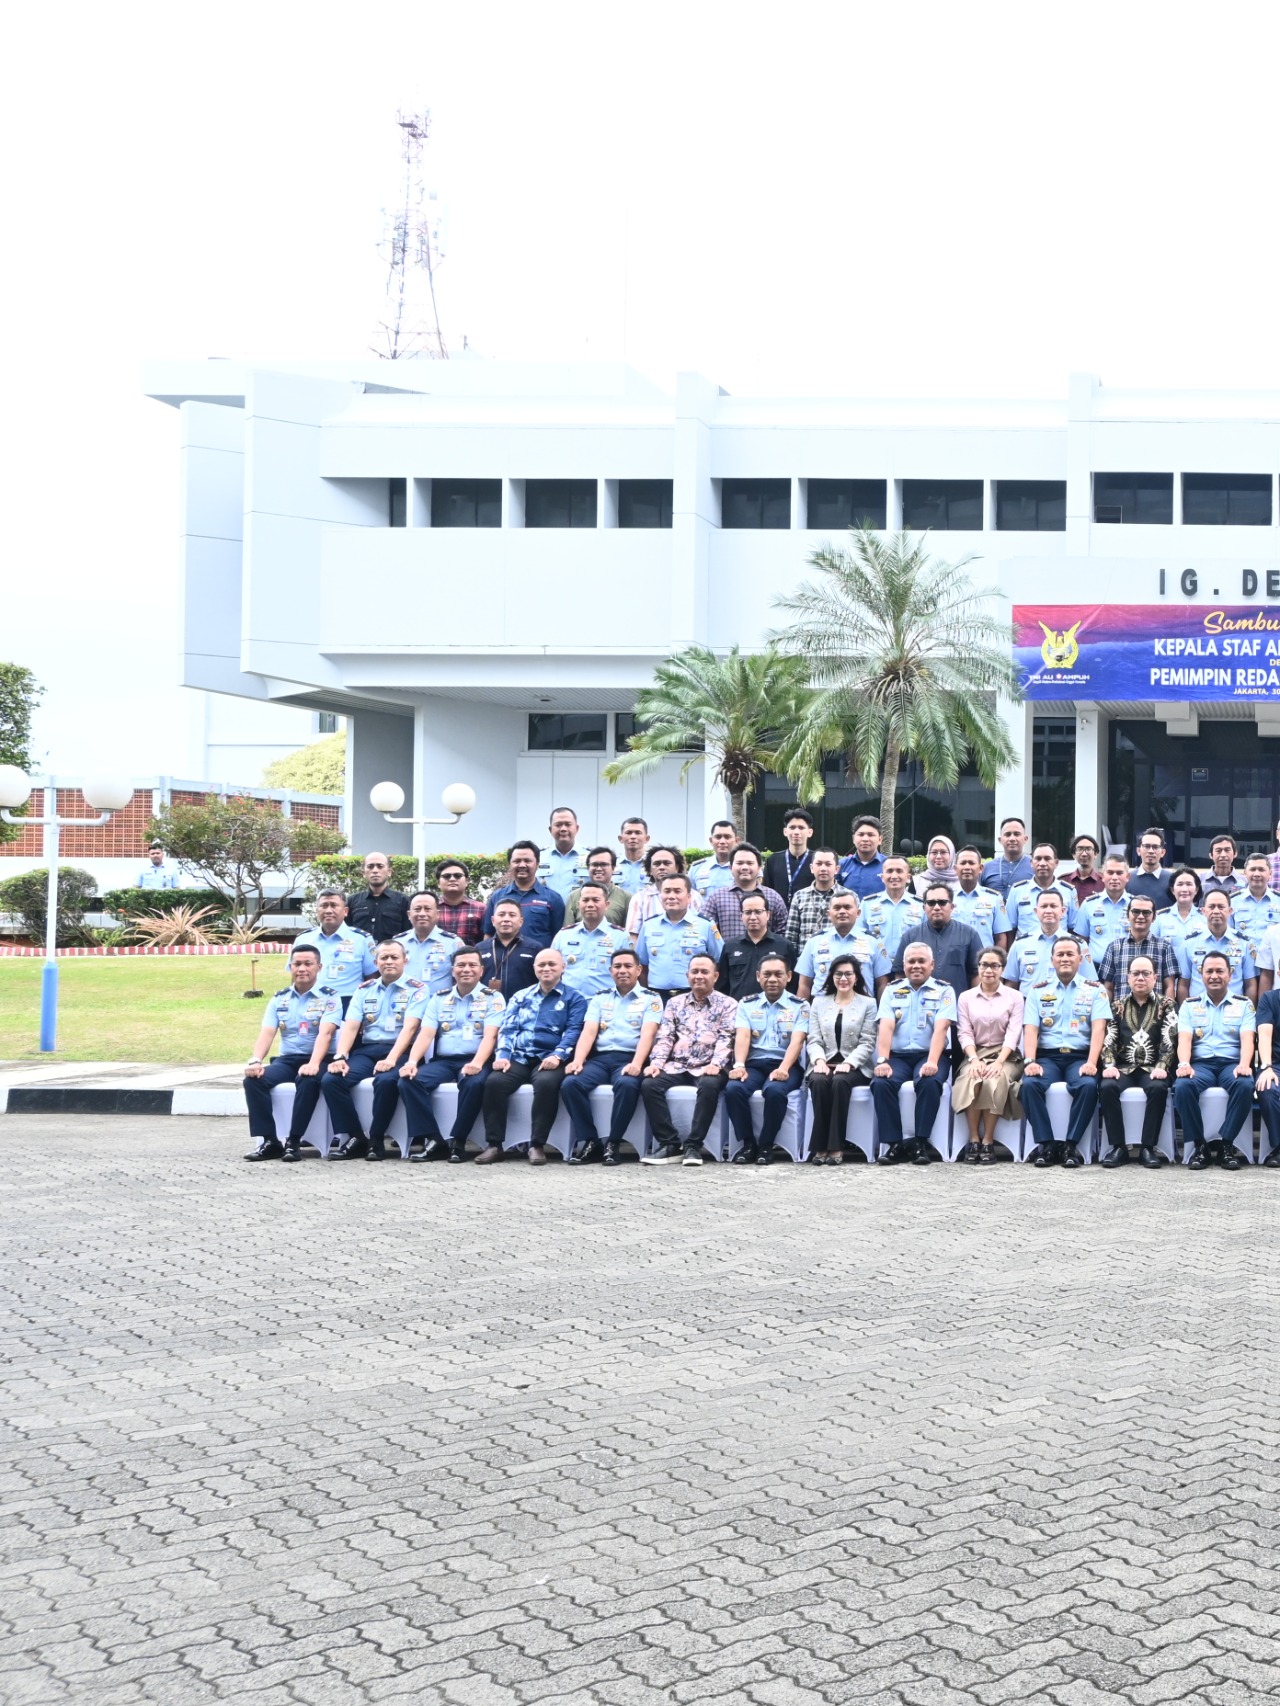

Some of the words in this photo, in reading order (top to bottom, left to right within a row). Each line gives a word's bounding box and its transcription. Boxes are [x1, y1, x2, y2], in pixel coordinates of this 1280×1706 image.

[1154, 638, 1218, 656] KEPALA
[1222, 638, 1261, 657] STAF
[1150, 668, 1232, 686] PEMIMPIN
